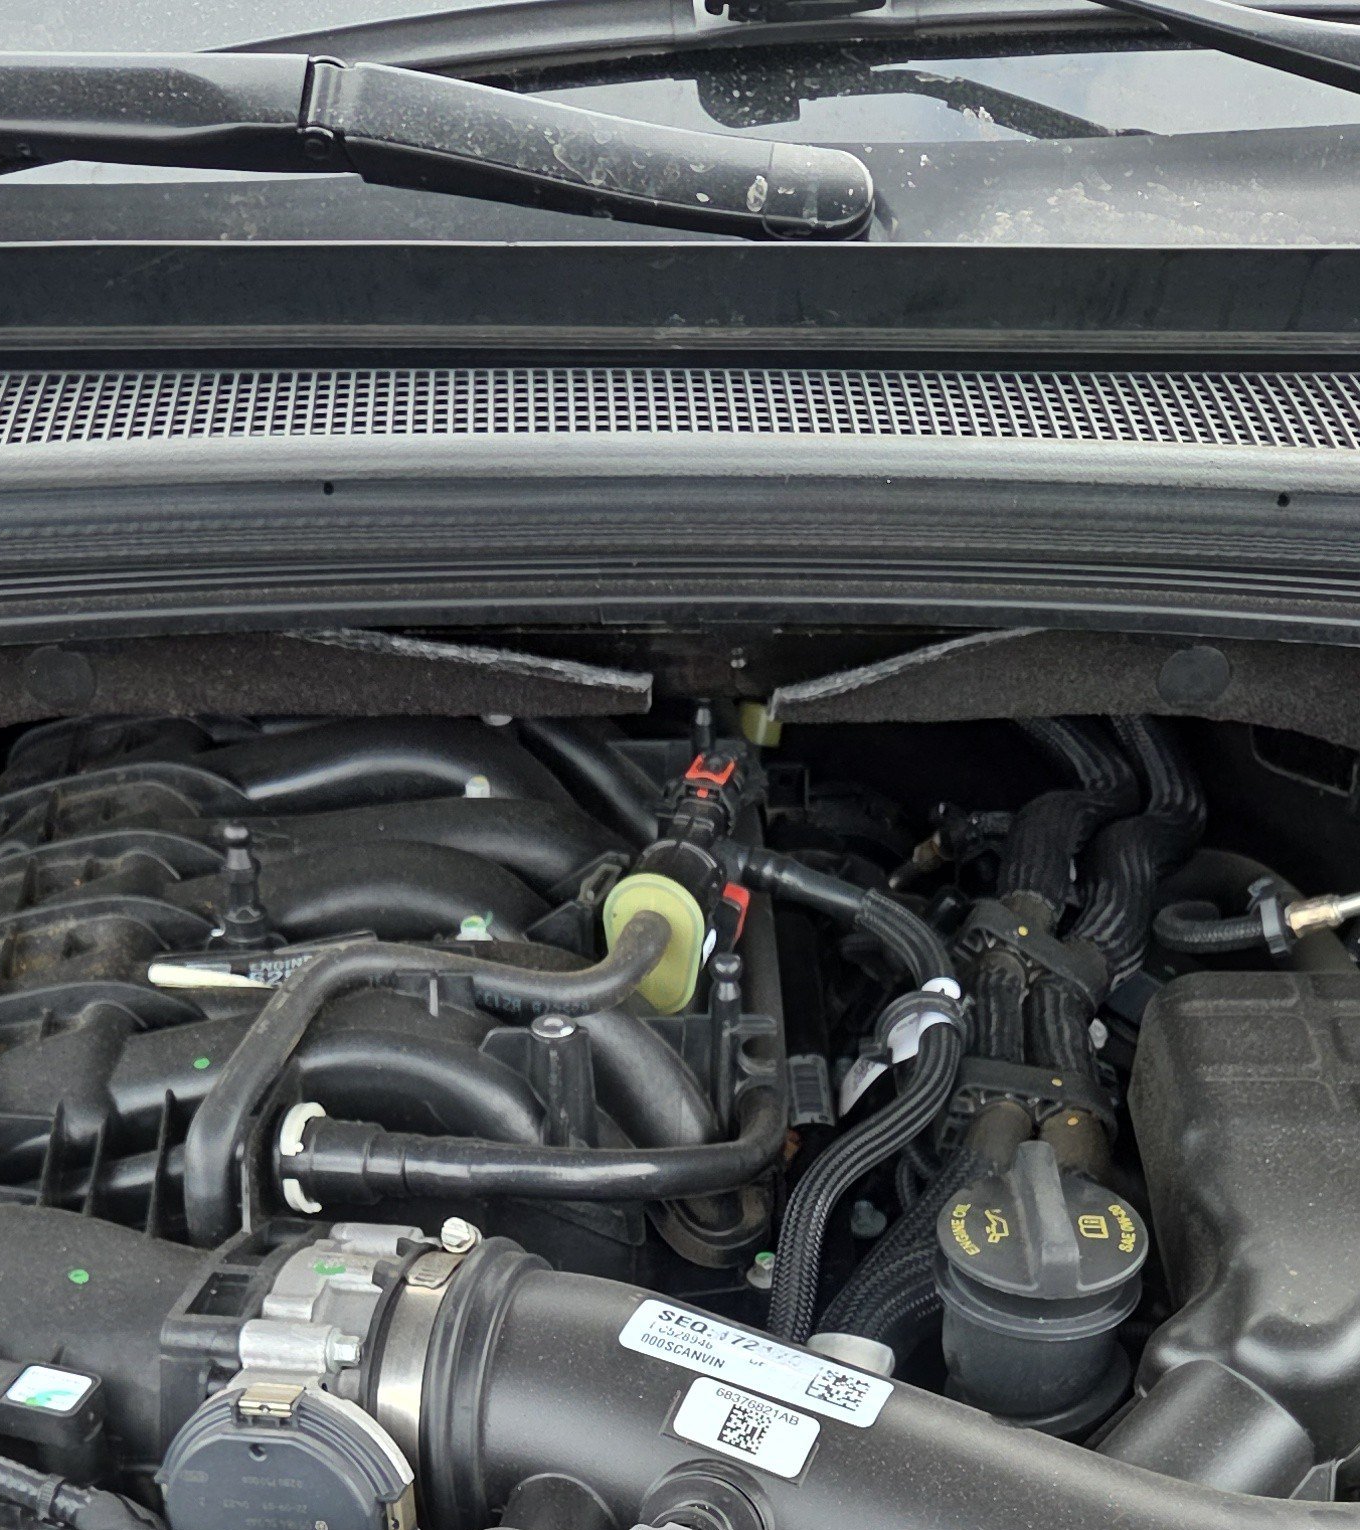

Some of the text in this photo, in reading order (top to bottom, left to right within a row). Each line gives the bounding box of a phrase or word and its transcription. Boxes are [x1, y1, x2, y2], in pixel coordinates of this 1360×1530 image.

[951, 1219, 980, 1255] ENGINE
[640, 1332, 726, 1370] 000SCANVIN
[715, 1387, 800, 1426] 68376821AB
